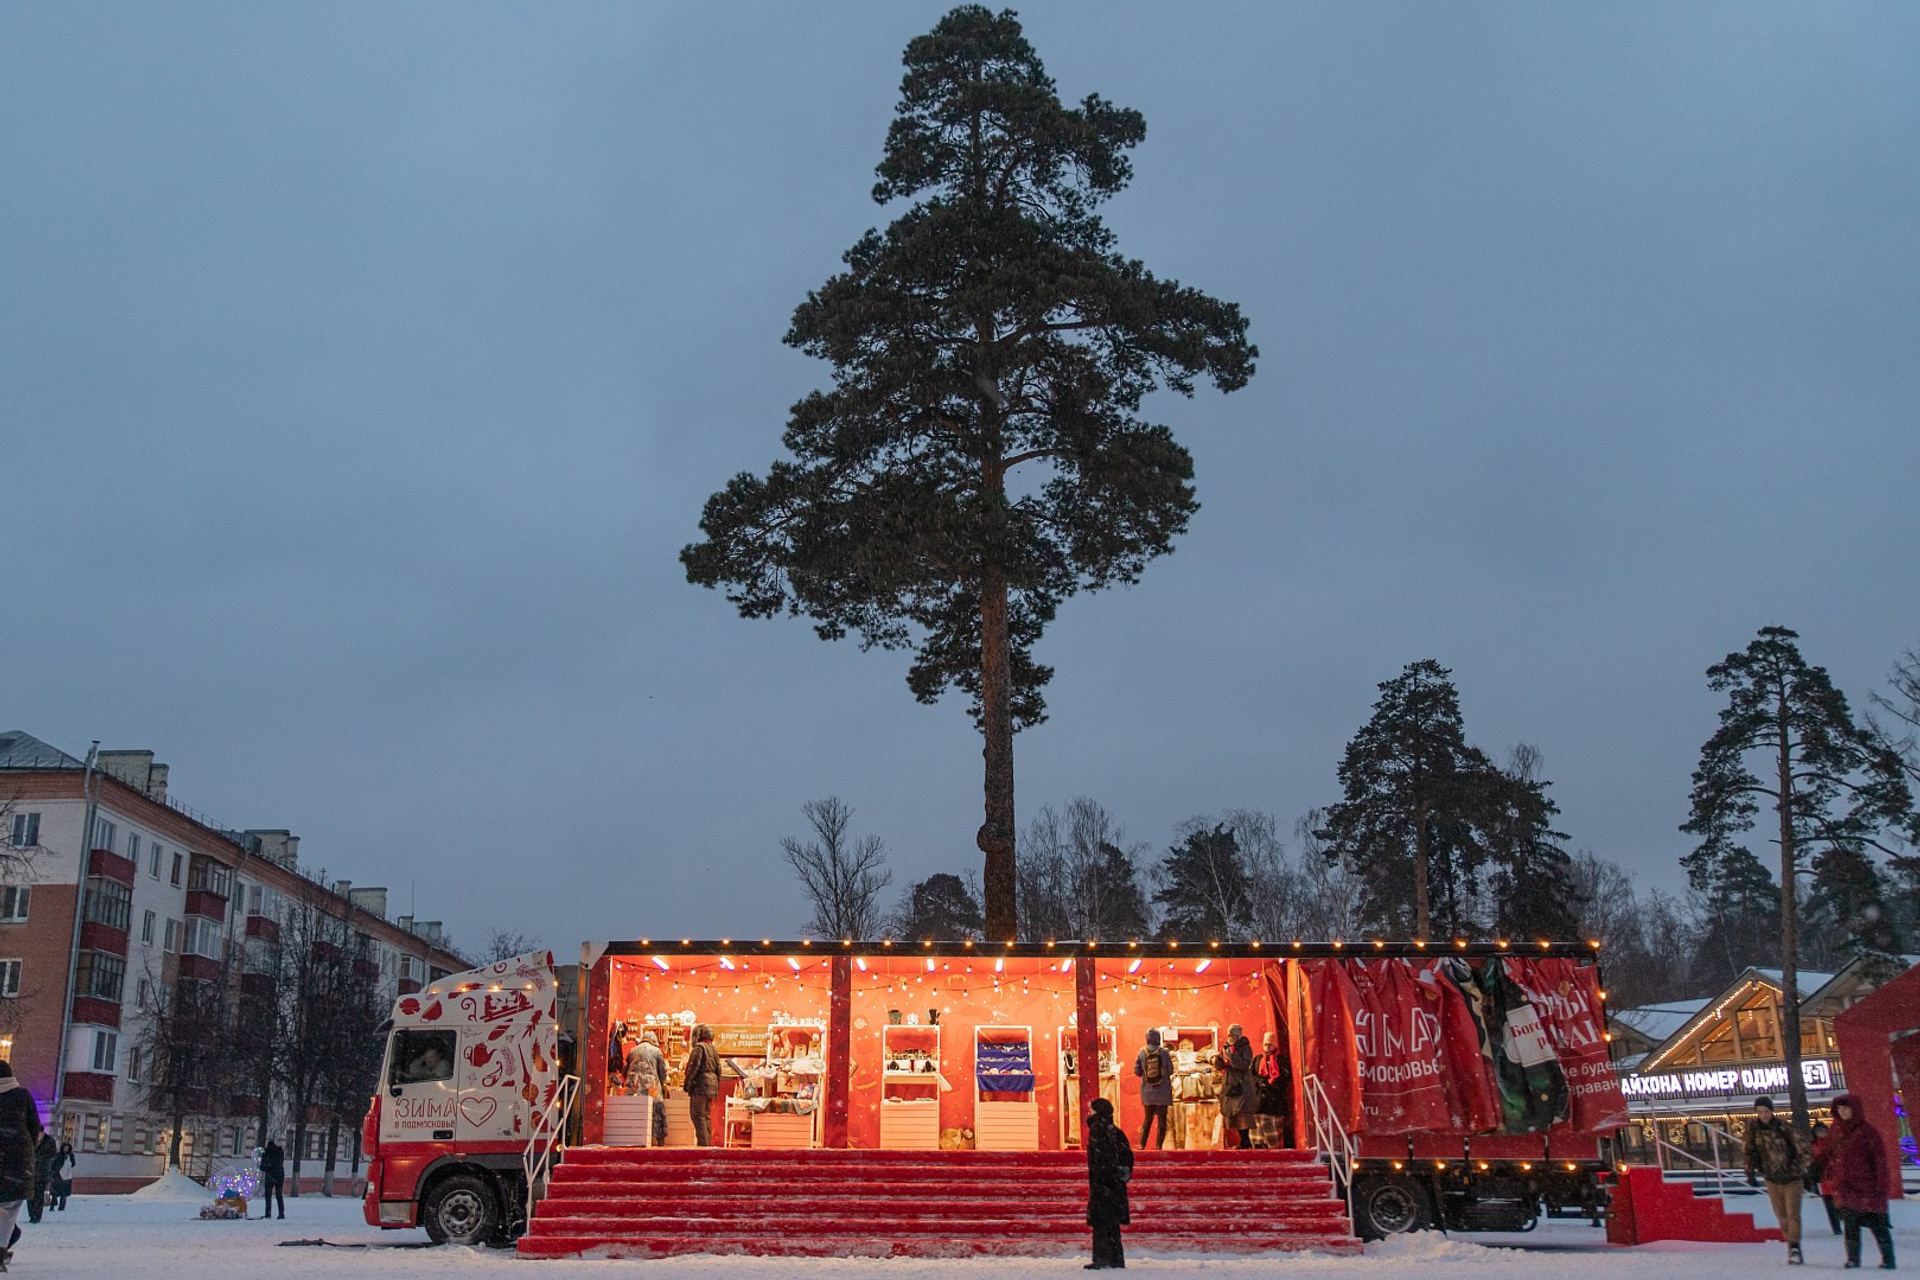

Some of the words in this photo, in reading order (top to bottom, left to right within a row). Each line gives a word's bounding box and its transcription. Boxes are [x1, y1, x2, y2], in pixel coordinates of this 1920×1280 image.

[1621, 1073, 1683, 1095] АЙХОНА
[1684, 1070, 1739, 1093] НОМЕР
[1741, 1067, 1790, 1090] ОДИН
[395, 1097, 457, 1118] ЗИМА
